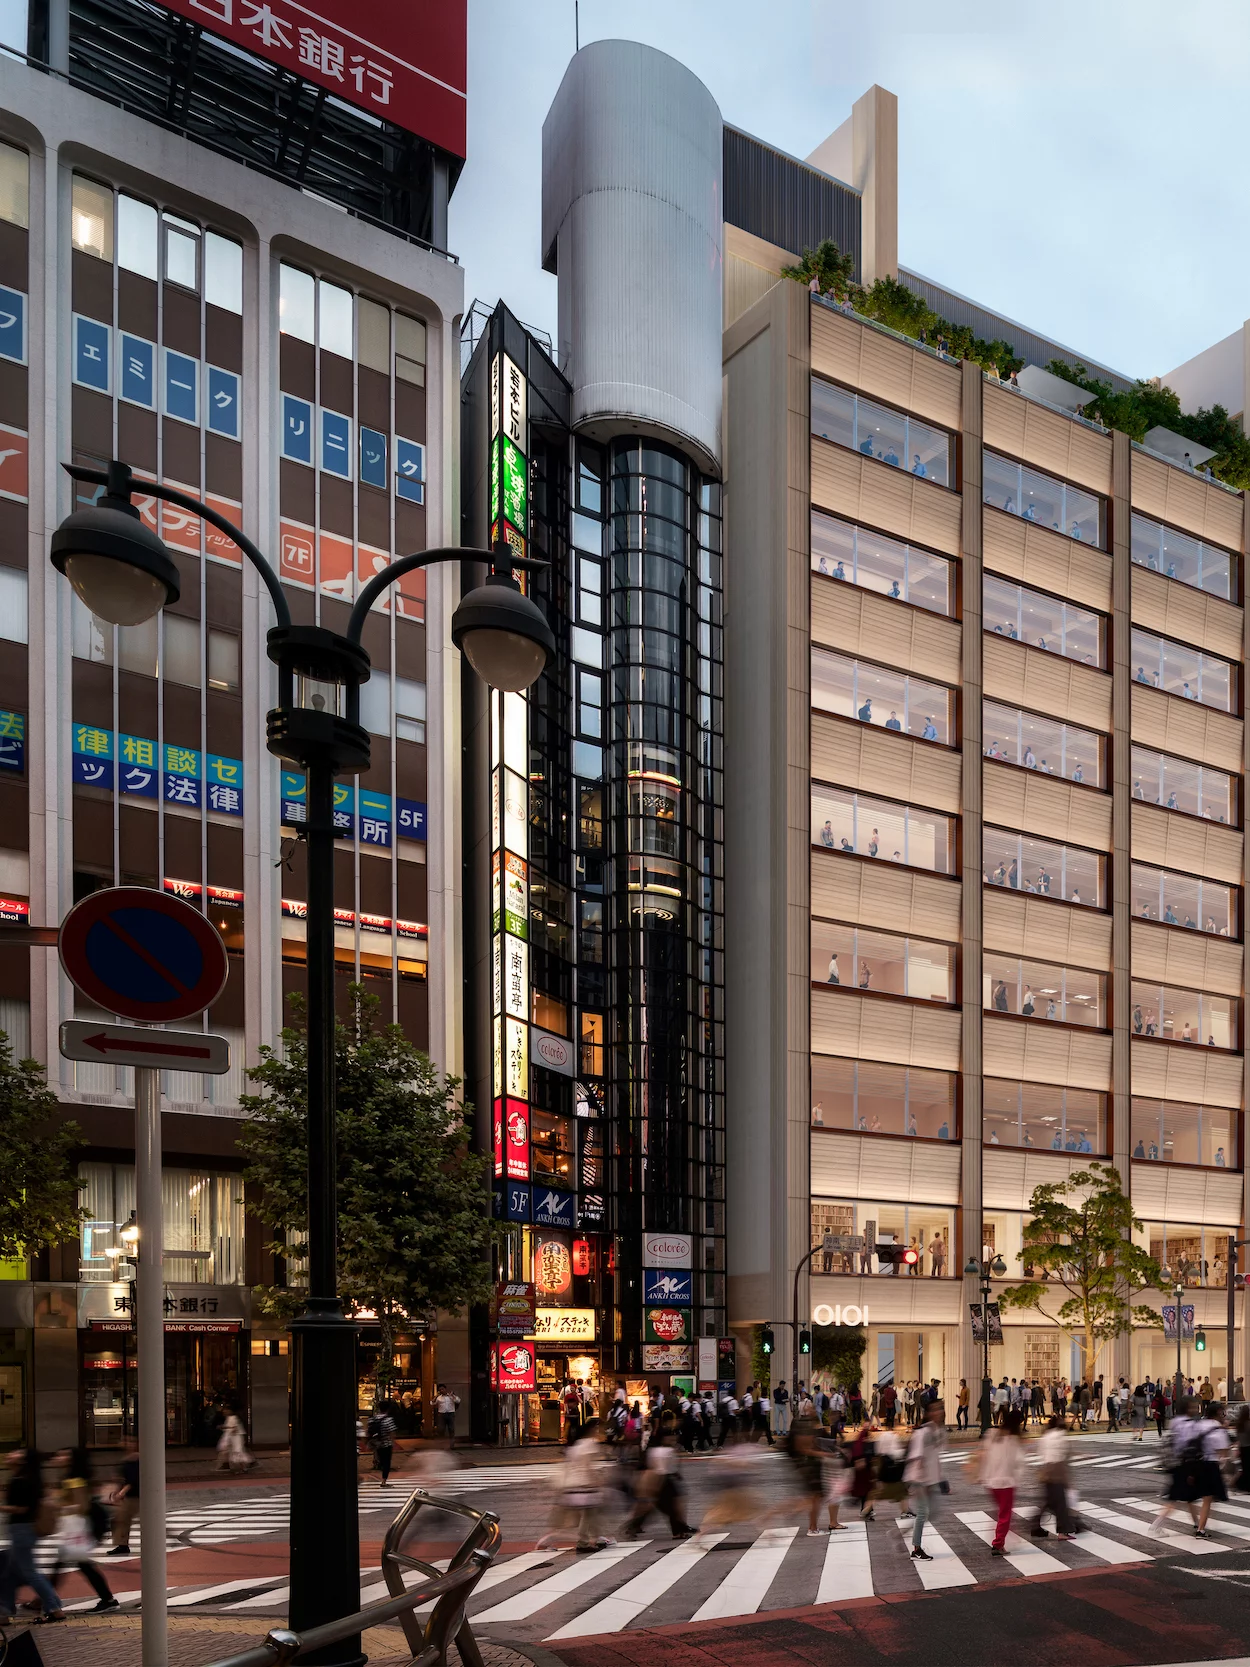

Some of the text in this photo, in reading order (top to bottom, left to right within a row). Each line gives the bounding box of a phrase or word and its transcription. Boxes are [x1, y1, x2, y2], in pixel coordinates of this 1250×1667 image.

[286, 540, 309, 564] 7F
[400, 809, 423, 828] 5F
[172, 883, 194, 899] We
[511, 1191, 528, 1212] 5F
[552, 1215, 571, 1227] CROSS
[206, 1324, 230, 1332] Corner
